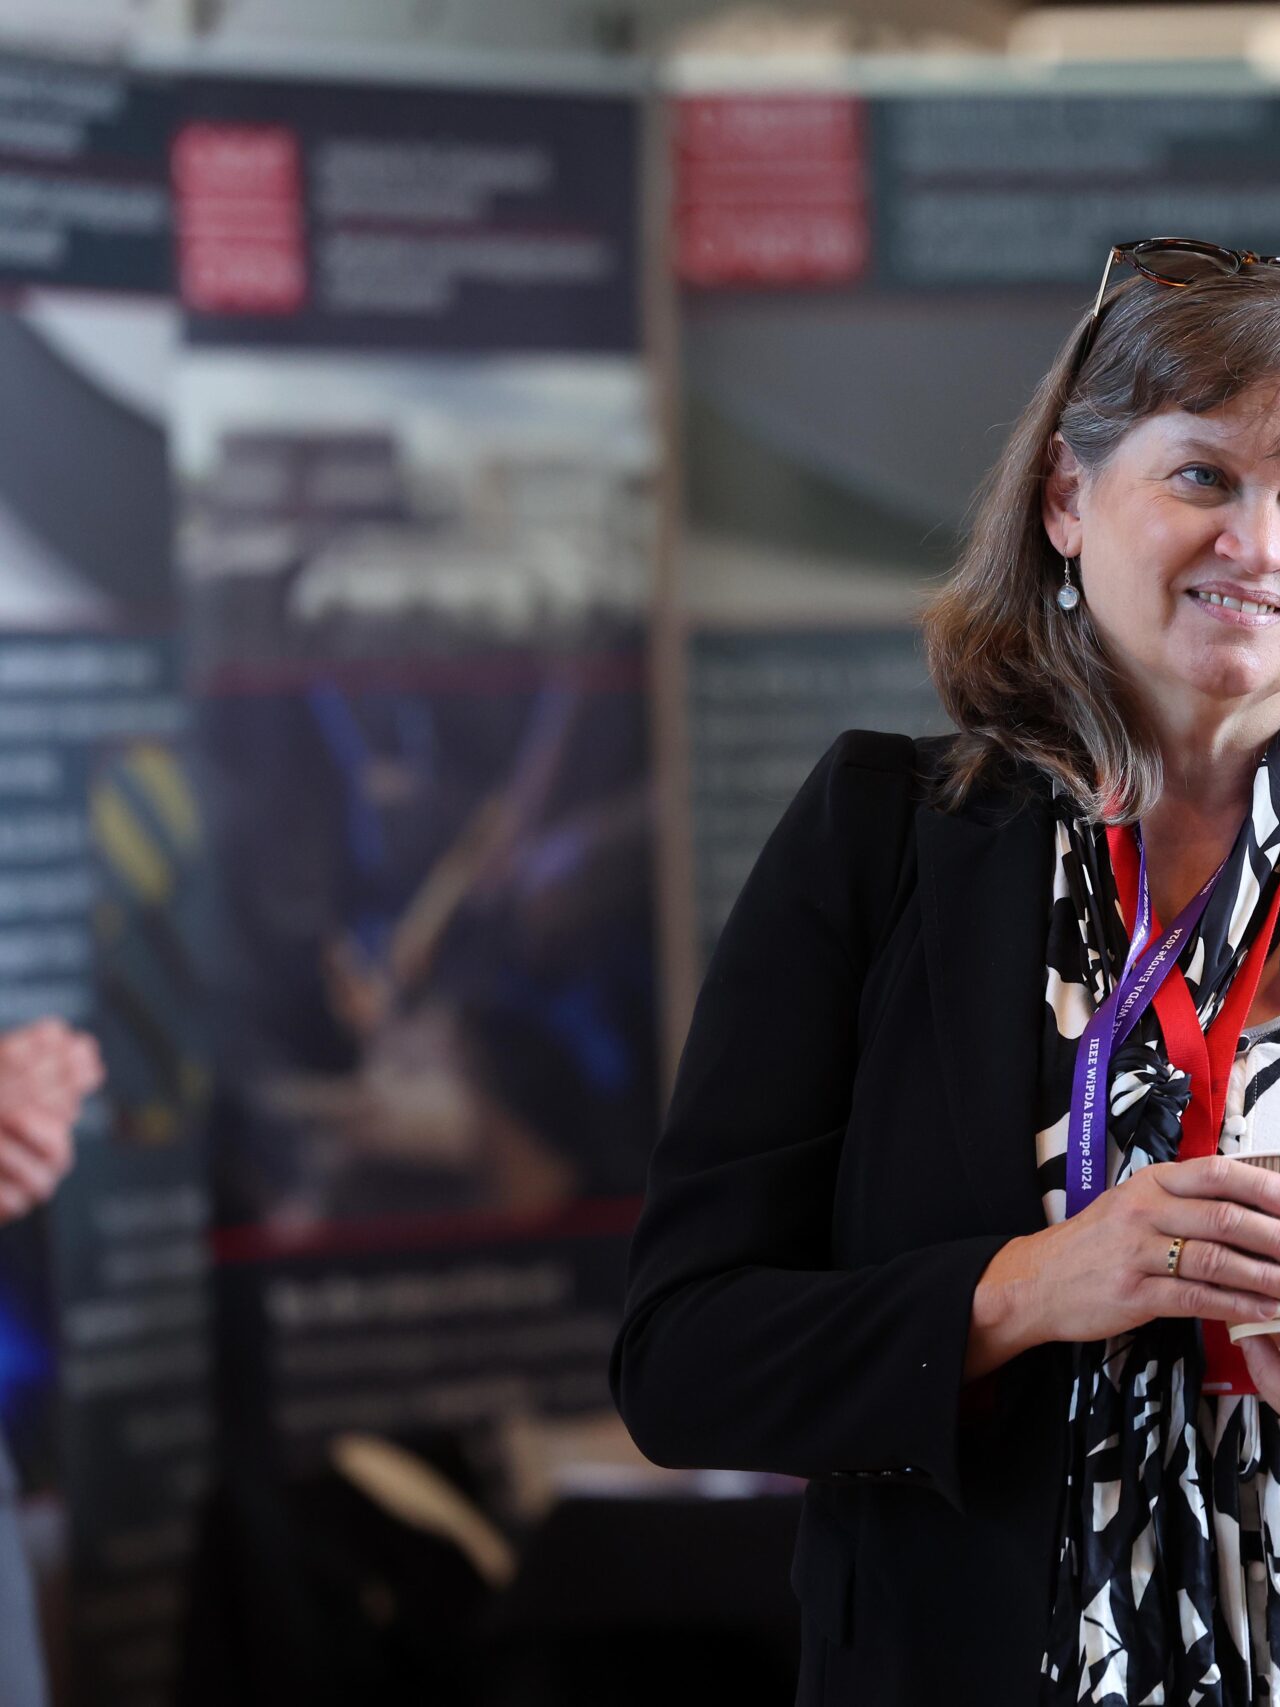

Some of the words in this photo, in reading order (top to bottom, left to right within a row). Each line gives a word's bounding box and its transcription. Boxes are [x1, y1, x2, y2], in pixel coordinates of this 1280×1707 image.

[1117, 984, 1145, 1019] WiPDA
[1139, 949, 1168, 984] Europe
[1162, 927, 1183, 951] 2024
[1087, 1037, 1100, 1066] IEEE
[1083, 1067, 1097, 1111] WiPDA
[1079, 1112, 1093, 1157] Europe
[1081, 1158, 1093, 1191] 2024
